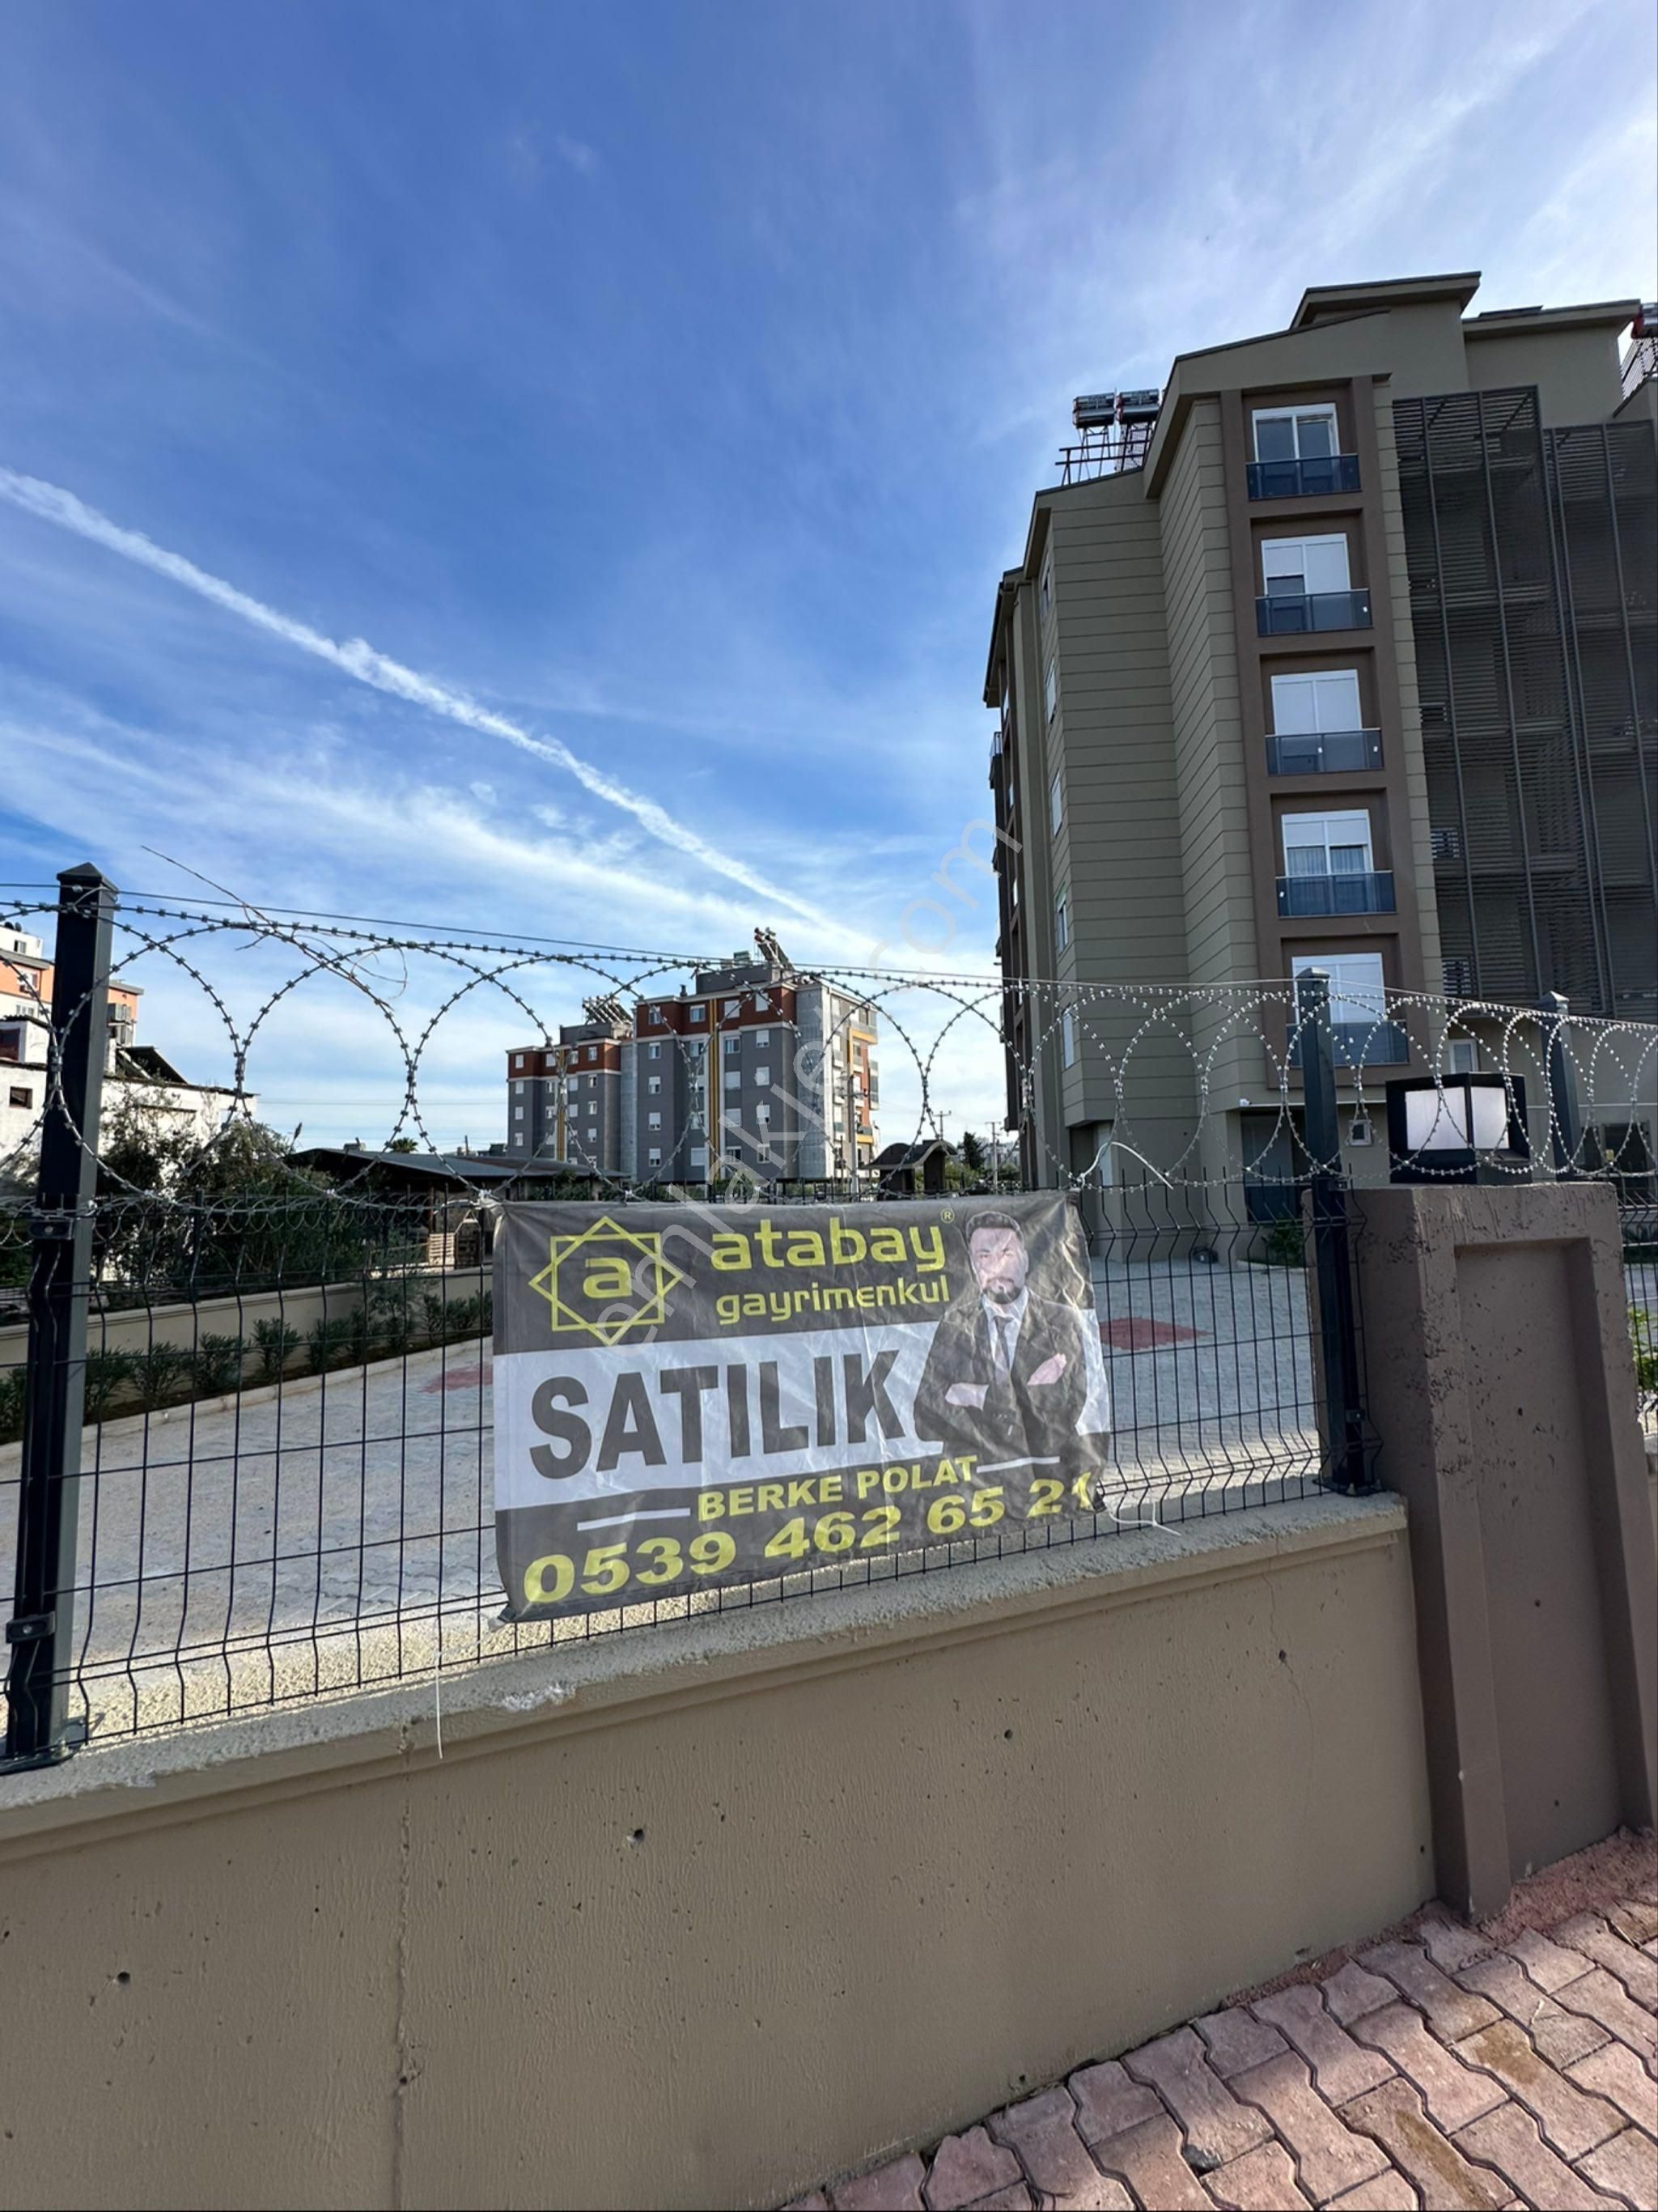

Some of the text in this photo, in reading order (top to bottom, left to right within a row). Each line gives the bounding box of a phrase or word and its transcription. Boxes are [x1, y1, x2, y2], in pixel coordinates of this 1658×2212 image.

[710, 1216, 946, 1273] atabay
[583, 1257, 633, 1299] a
[716, 1275, 950, 1325] gayrimenkul
[529, 1349, 906, 1480] SATILIK
[698, 1455, 977, 1522] BERKE POLAT
[523, 1531, 736, 1604] 0539
[764, 1505, 902, 1560] 462
[927, 1485, 1006, 1535] 65
